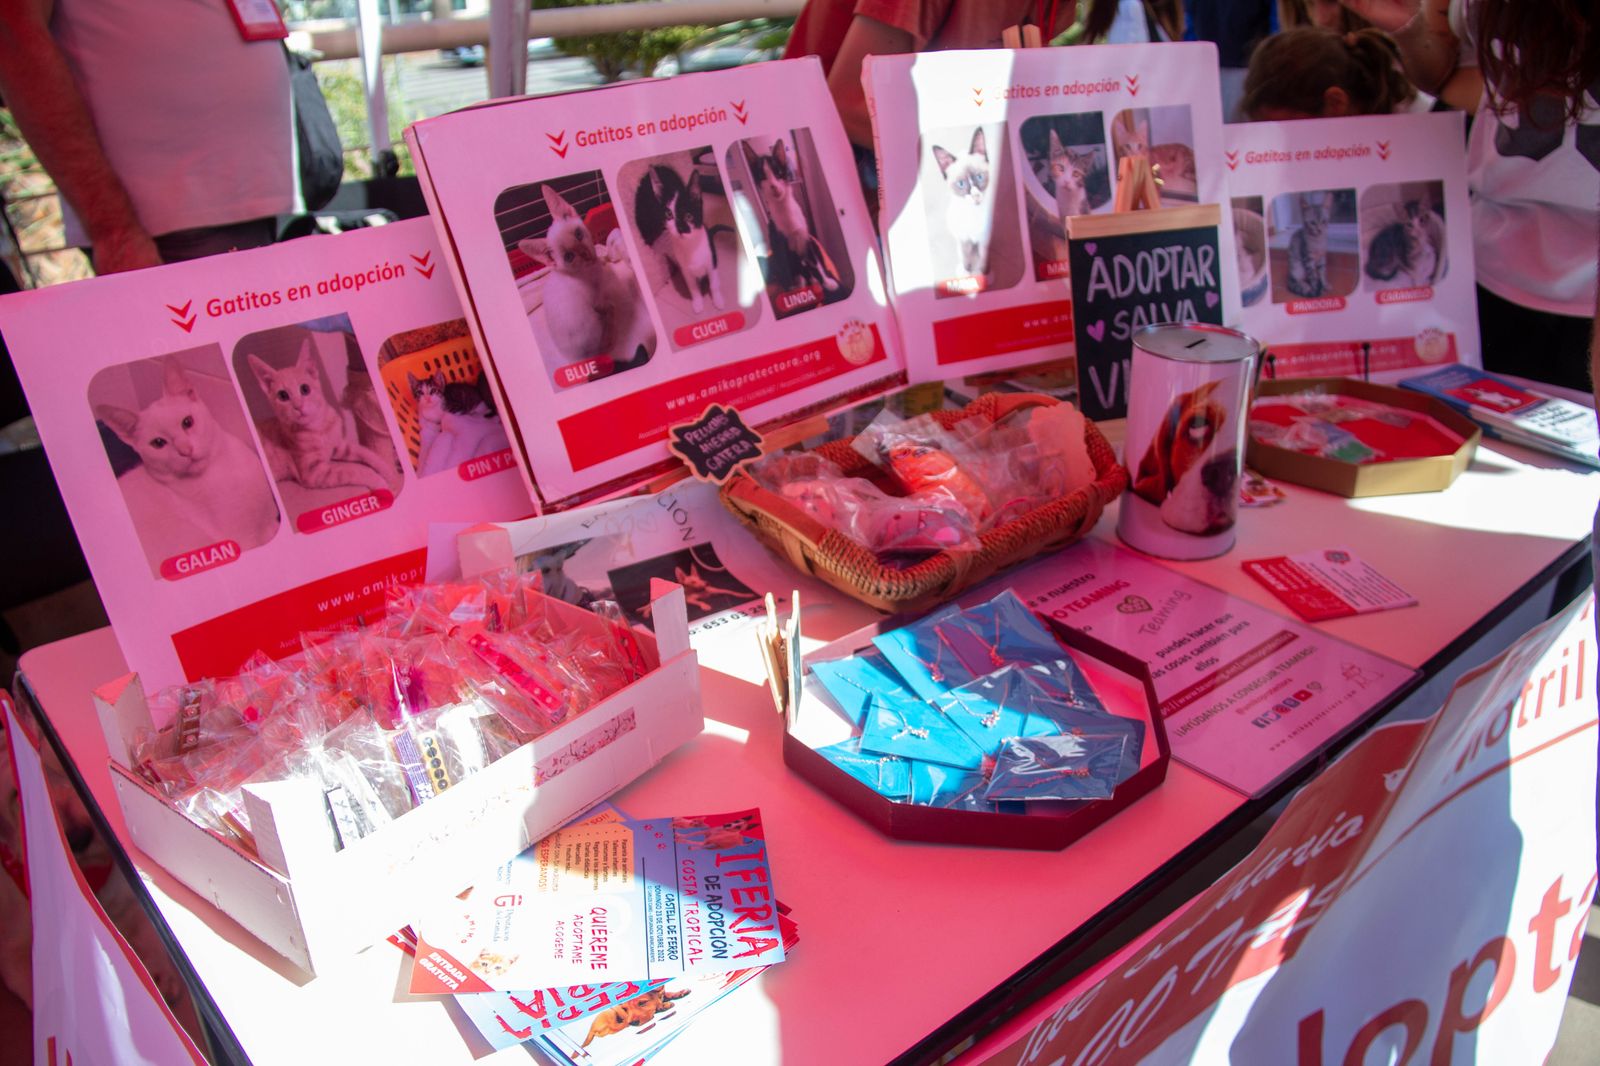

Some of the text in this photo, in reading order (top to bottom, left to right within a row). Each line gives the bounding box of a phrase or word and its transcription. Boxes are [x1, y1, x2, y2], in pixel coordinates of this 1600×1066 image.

[1044, 84, 1059, 96] en
[1062, 78, 1120, 97] adopción
[575, 106, 727, 147] Gatitos en adopción
[1245, 144, 1371, 164] Gatitos en adopción
[1087, 244, 1216, 303] ADOPTAR
[206, 262, 406, 318] Gatitos en adopción
[782, 287, 816, 309] LINDA
[1292, 299, 1341, 313] PANDORA
[691, 318, 728, 340] CUCHI
[1111, 299, 1199, 340] SALVA
[564, 361, 599, 383] BLUE
[467, 459, 492, 478] PIN
[321, 494, 381, 526] GINGER
[174, 542, 236, 574] GALAN
[1047, 572, 1096, 599] nuestro
[1066, 579, 1131, 613] TEAMING
[702, 617, 729, 630] 653
[1137, 588, 1193, 636] Teaming
[1155, 613, 1234, 659] puedes hacer que
[1164, 653, 1193, 672] cosas
[1191, 633, 1229, 657] cambien
[1228, 620, 1250, 636] para
[1194, 656, 1220, 673] ellos
[1232, 669, 1280, 703] CONSEGUIR
[574, 843, 583, 865] Mercadillo
[592, 842, 600, 857] Regalos
[602, 841, 610, 862] Concursos
[654, 886, 662, 909] DOMINGO
[682, 859, 703, 965] COSTA TROPICAL
[724, 866, 780, 959] FERIA
[665, 893, 679, 961] CASTELL DE FERRO
[704, 875, 733, 959] DE ADOPCIÓN
[656, 926, 664, 948] OCTUBRE
[428, 951, 468, 983] ENTRADA
[657, 949, 665, 962] 2022
[419, 957, 460, 990] GRATUITA
